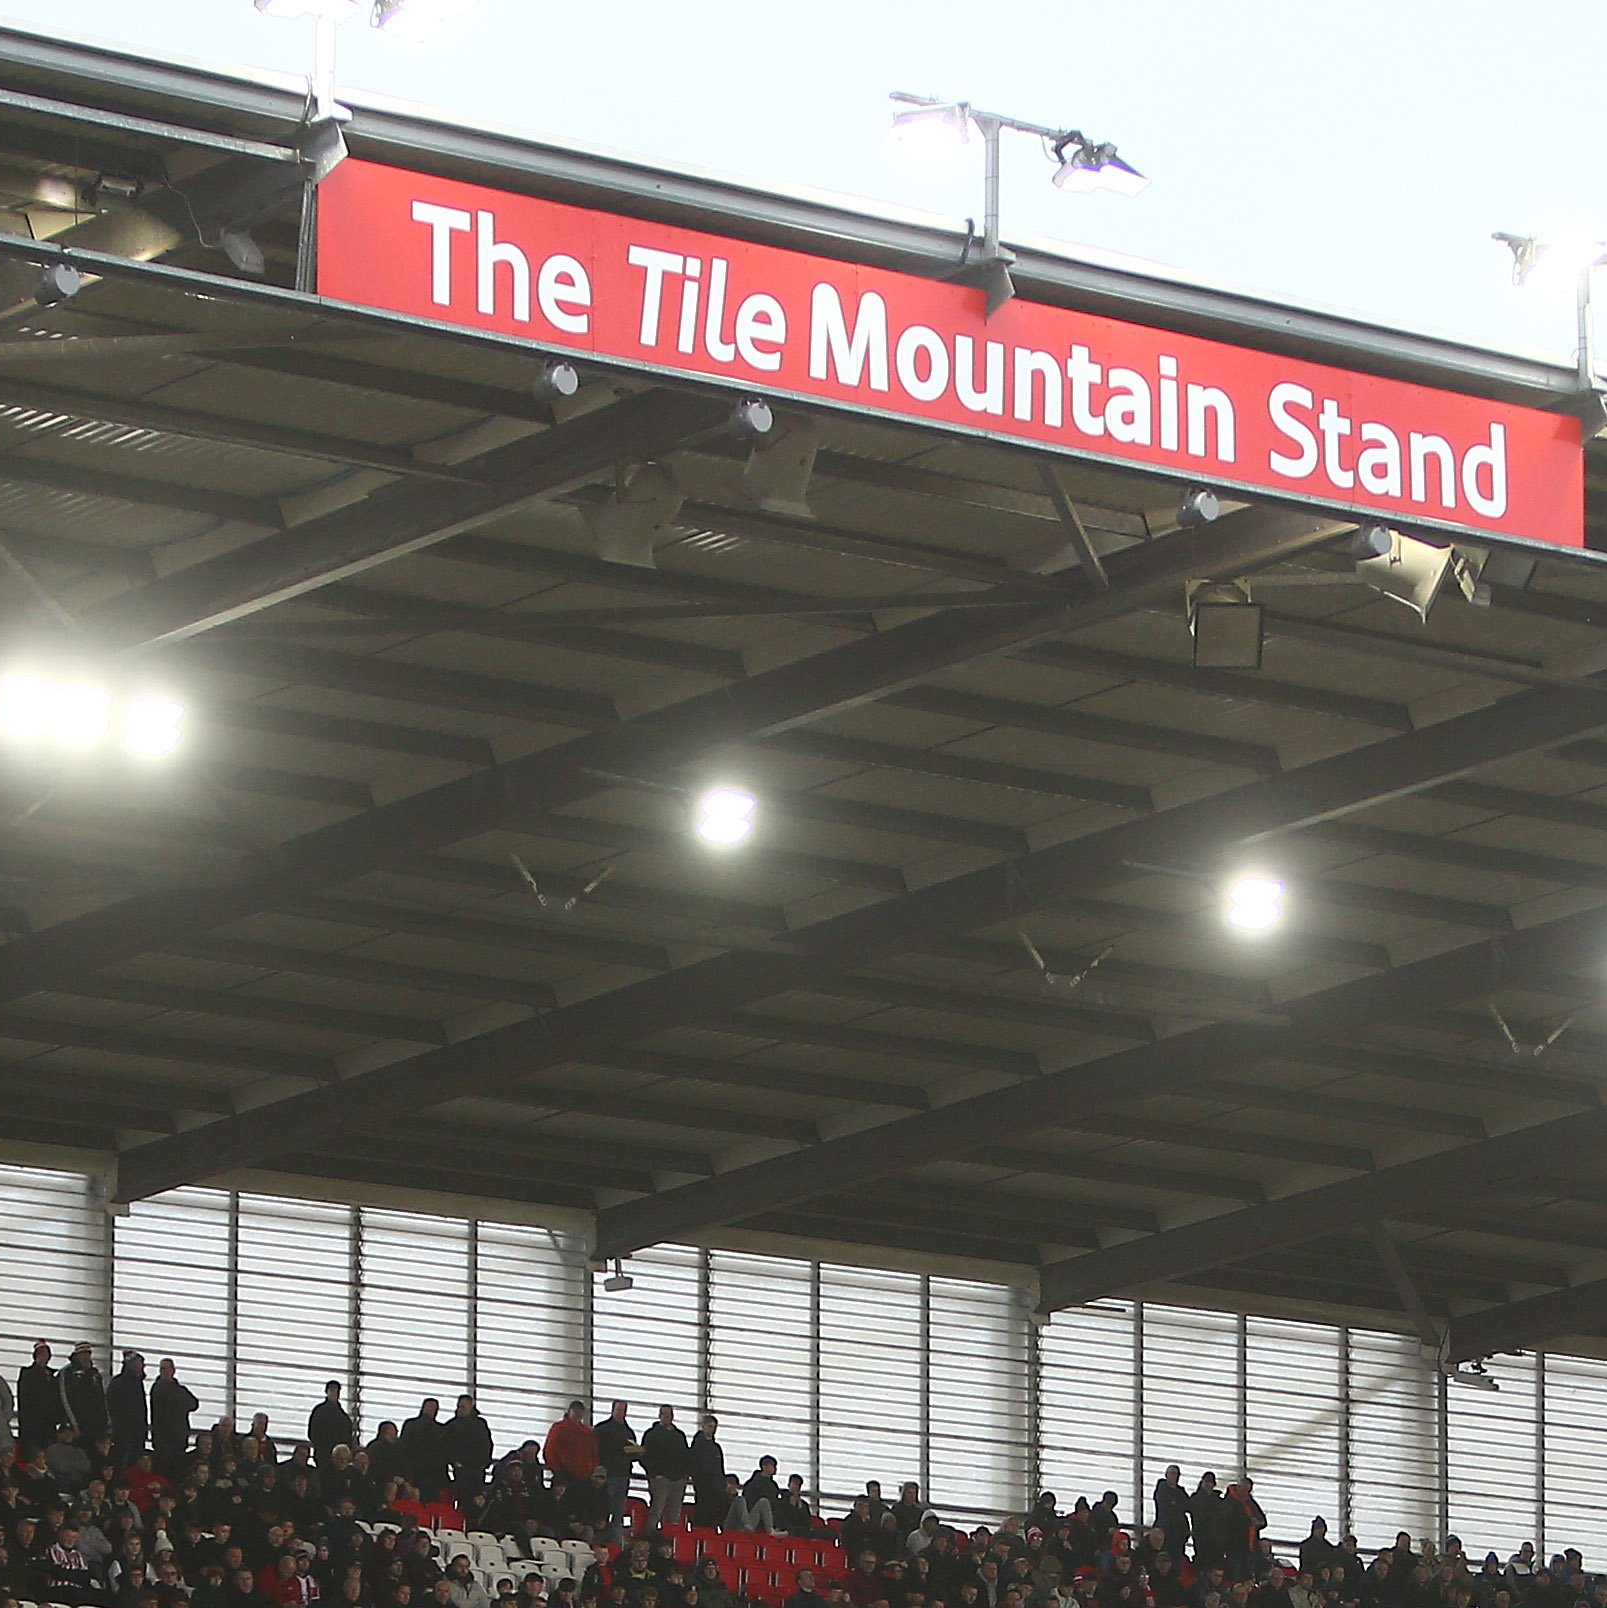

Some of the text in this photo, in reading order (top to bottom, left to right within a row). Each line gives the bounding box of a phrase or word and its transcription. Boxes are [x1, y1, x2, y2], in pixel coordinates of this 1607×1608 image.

[410, 199, 1510, 520] The Tile Mountain Stand
